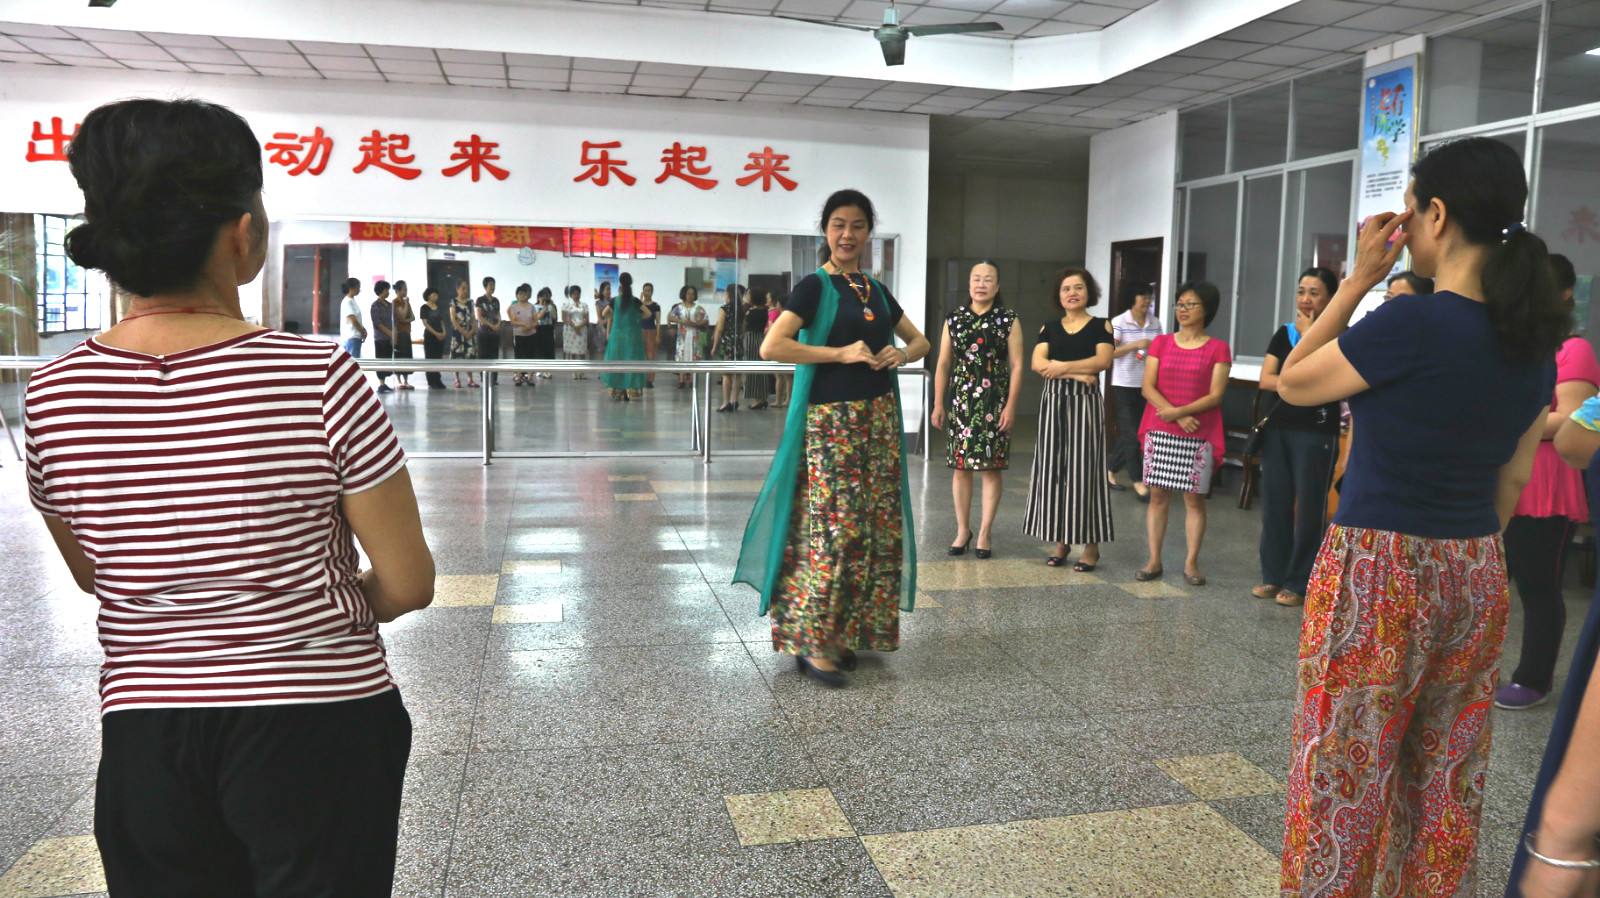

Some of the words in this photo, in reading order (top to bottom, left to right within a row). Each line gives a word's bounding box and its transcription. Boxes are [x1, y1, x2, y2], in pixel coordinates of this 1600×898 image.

[264, 126, 511, 183] 动起来
[573, 140, 799, 193] 乐起来
